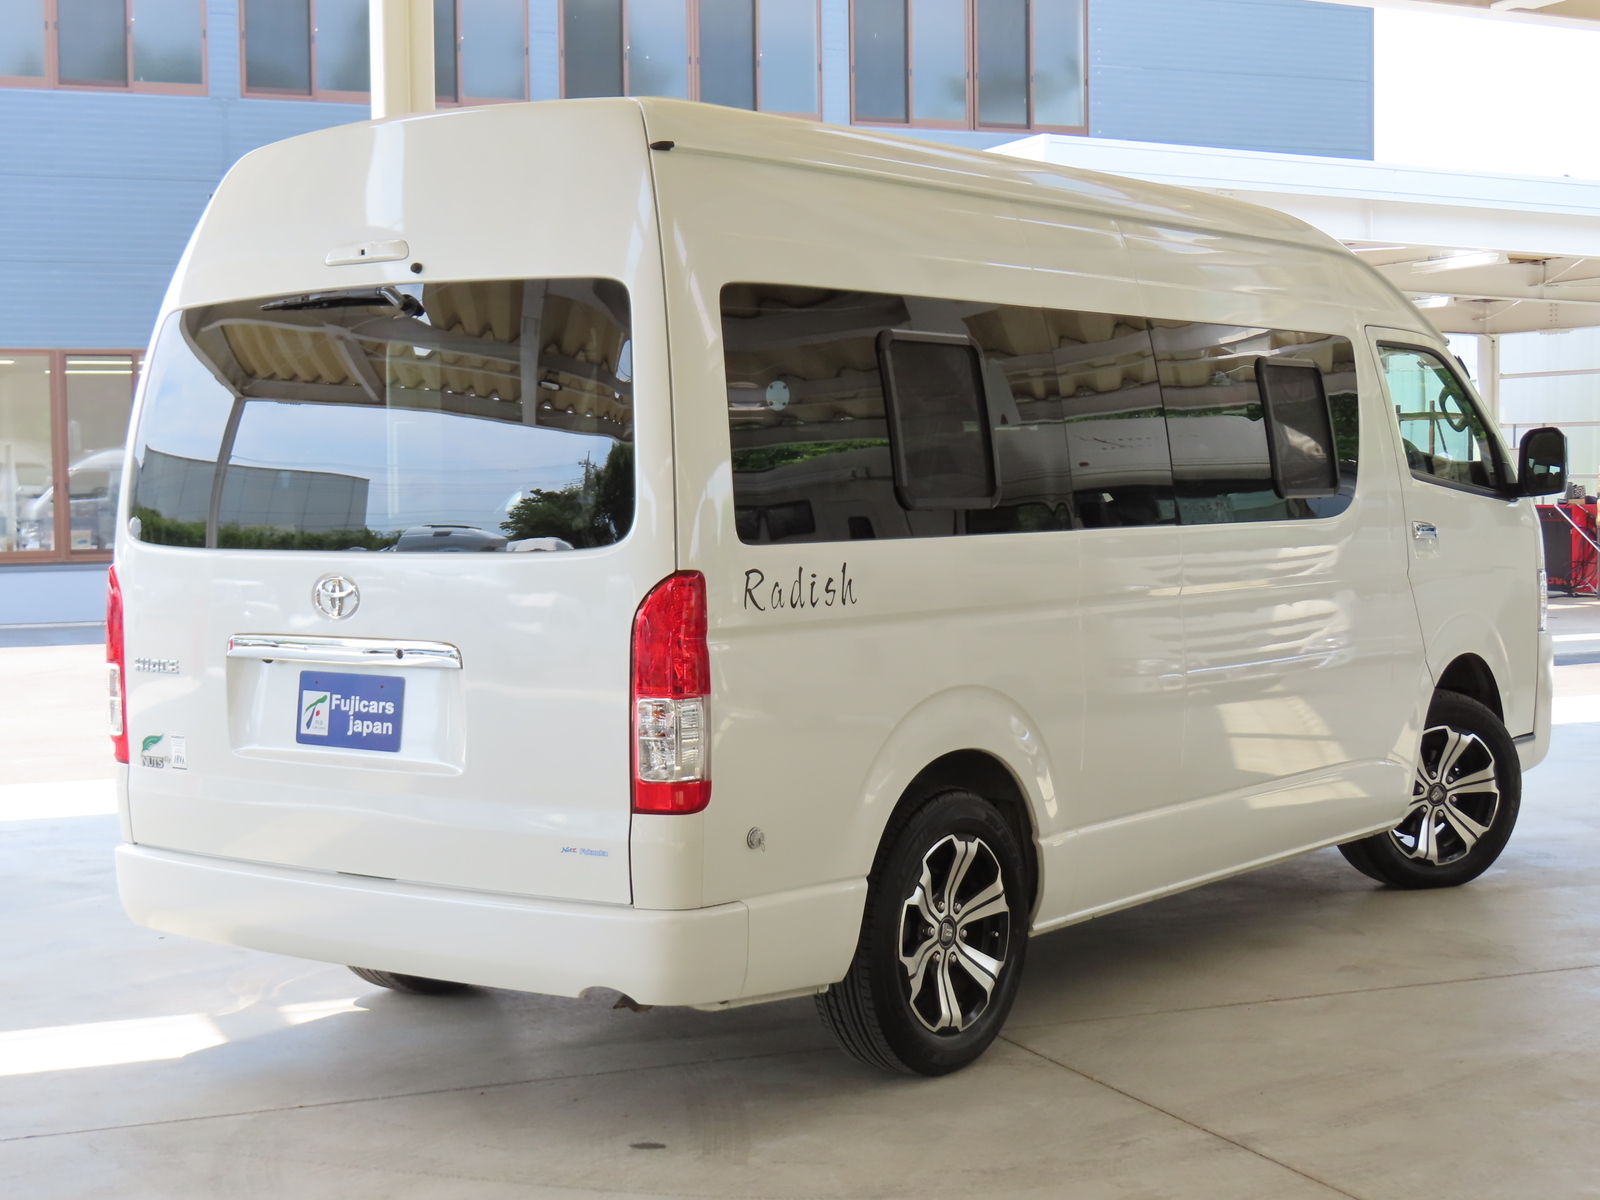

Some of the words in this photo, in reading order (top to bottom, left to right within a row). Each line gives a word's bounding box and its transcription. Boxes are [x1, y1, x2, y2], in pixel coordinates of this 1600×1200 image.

[744, 562, 857, 611] Radish
[135, 657, 179, 674] HIACE
[331, 694, 395, 715] Fujicars
[347, 716, 393, 736] japan
[141, 755, 165, 769] NUTS
